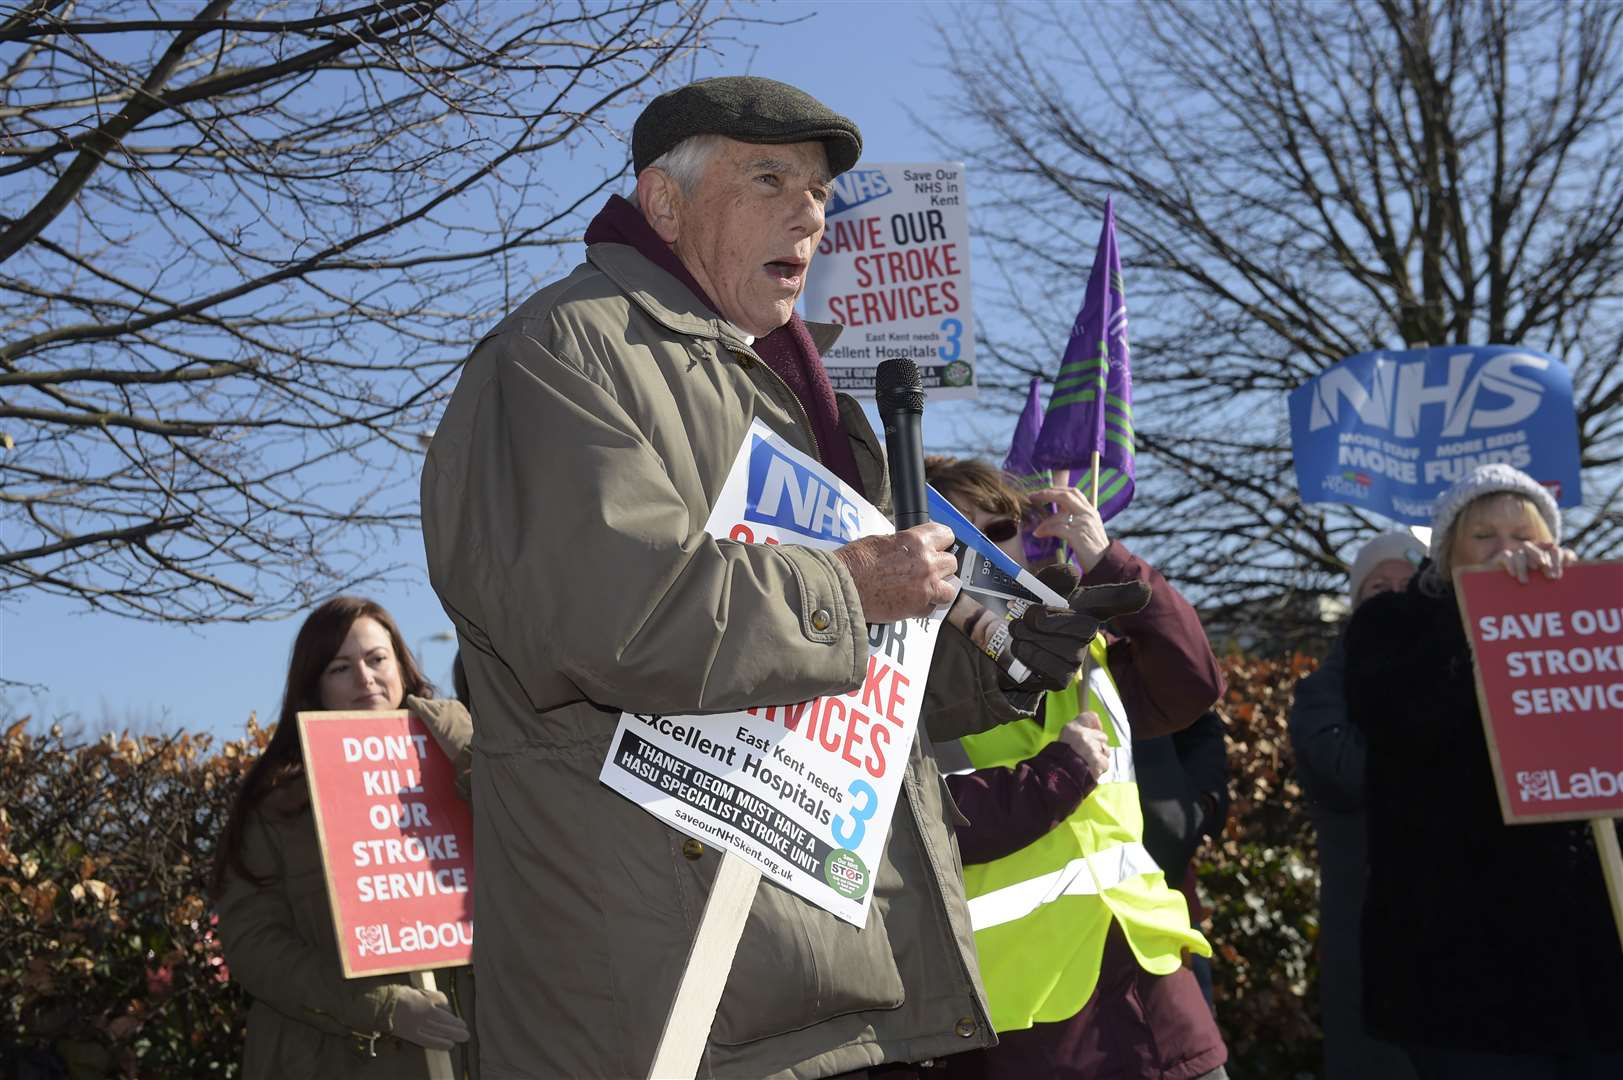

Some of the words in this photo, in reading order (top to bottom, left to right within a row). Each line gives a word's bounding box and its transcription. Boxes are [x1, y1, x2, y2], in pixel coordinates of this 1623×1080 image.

[826, 171, 889, 212] NHS
[904, 170, 931, 181] Save
[936, 170, 957, 181] Our
[914, 182, 944, 193] NHS
[947, 183, 958, 193] in
[931, 195, 960, 206] Kent
[818, 216, 886, 255] SAVE
[891, 209, 946, 245] OUR
[854, 244, 961, 288] STROKE
[828, 282, 960, 327] SERVICES
[822, 346, 870, 359] cellent
[866, 333, 886, 342] East
[889, 332, 909, 342] Kent
[913, 332, 939, 342] needs
[939, 318, 963, 362] 3
[1309, 352, 1550, 439] NHS
[1339, 445, 1418, 485] MORE
[1436, 439, 1483, 457] MORE
[756, 454, 862, 541] NHS
[1479, 612, 1564, 641] SAVE
[1571, 608, 1623, 635] OU
[1512, 683, 1623, 716] SERVIC
[342, 734, 428, 763] DON'T
[747, 696, 890, 778] VICES
[363, 769, 424, 796] KILL
[736, 726, 770, 753] East
[773, 745, 805, 776] Kent
[807, 771, 843, 803] needs
[638, 740, 692, 779] THANET
[692, 771, 735, 801] QEQM
[736, 791, 774, 822] MUST
[774, 816, 808, 845] HAVE
[806, 838, 816, 853] A
[742, 753, 831, 825] Hospitals
[369, 803, 432, 830] OUR
[621, 751, 660, 782] HASU
[660, 774, 742, 823] SPECIALIST
[741, 814, 790, 855] STROKE
[790, 846, 820, 874] UNIT
[831, 779, 878, 851] 3
[352, 834, 460, 867] STROKE
[674, 809, 793, 882] saveourNHSkent.org.uk
[356, 868, 469, 903] SERVICE
[383, 920, 474, 954] Labou
